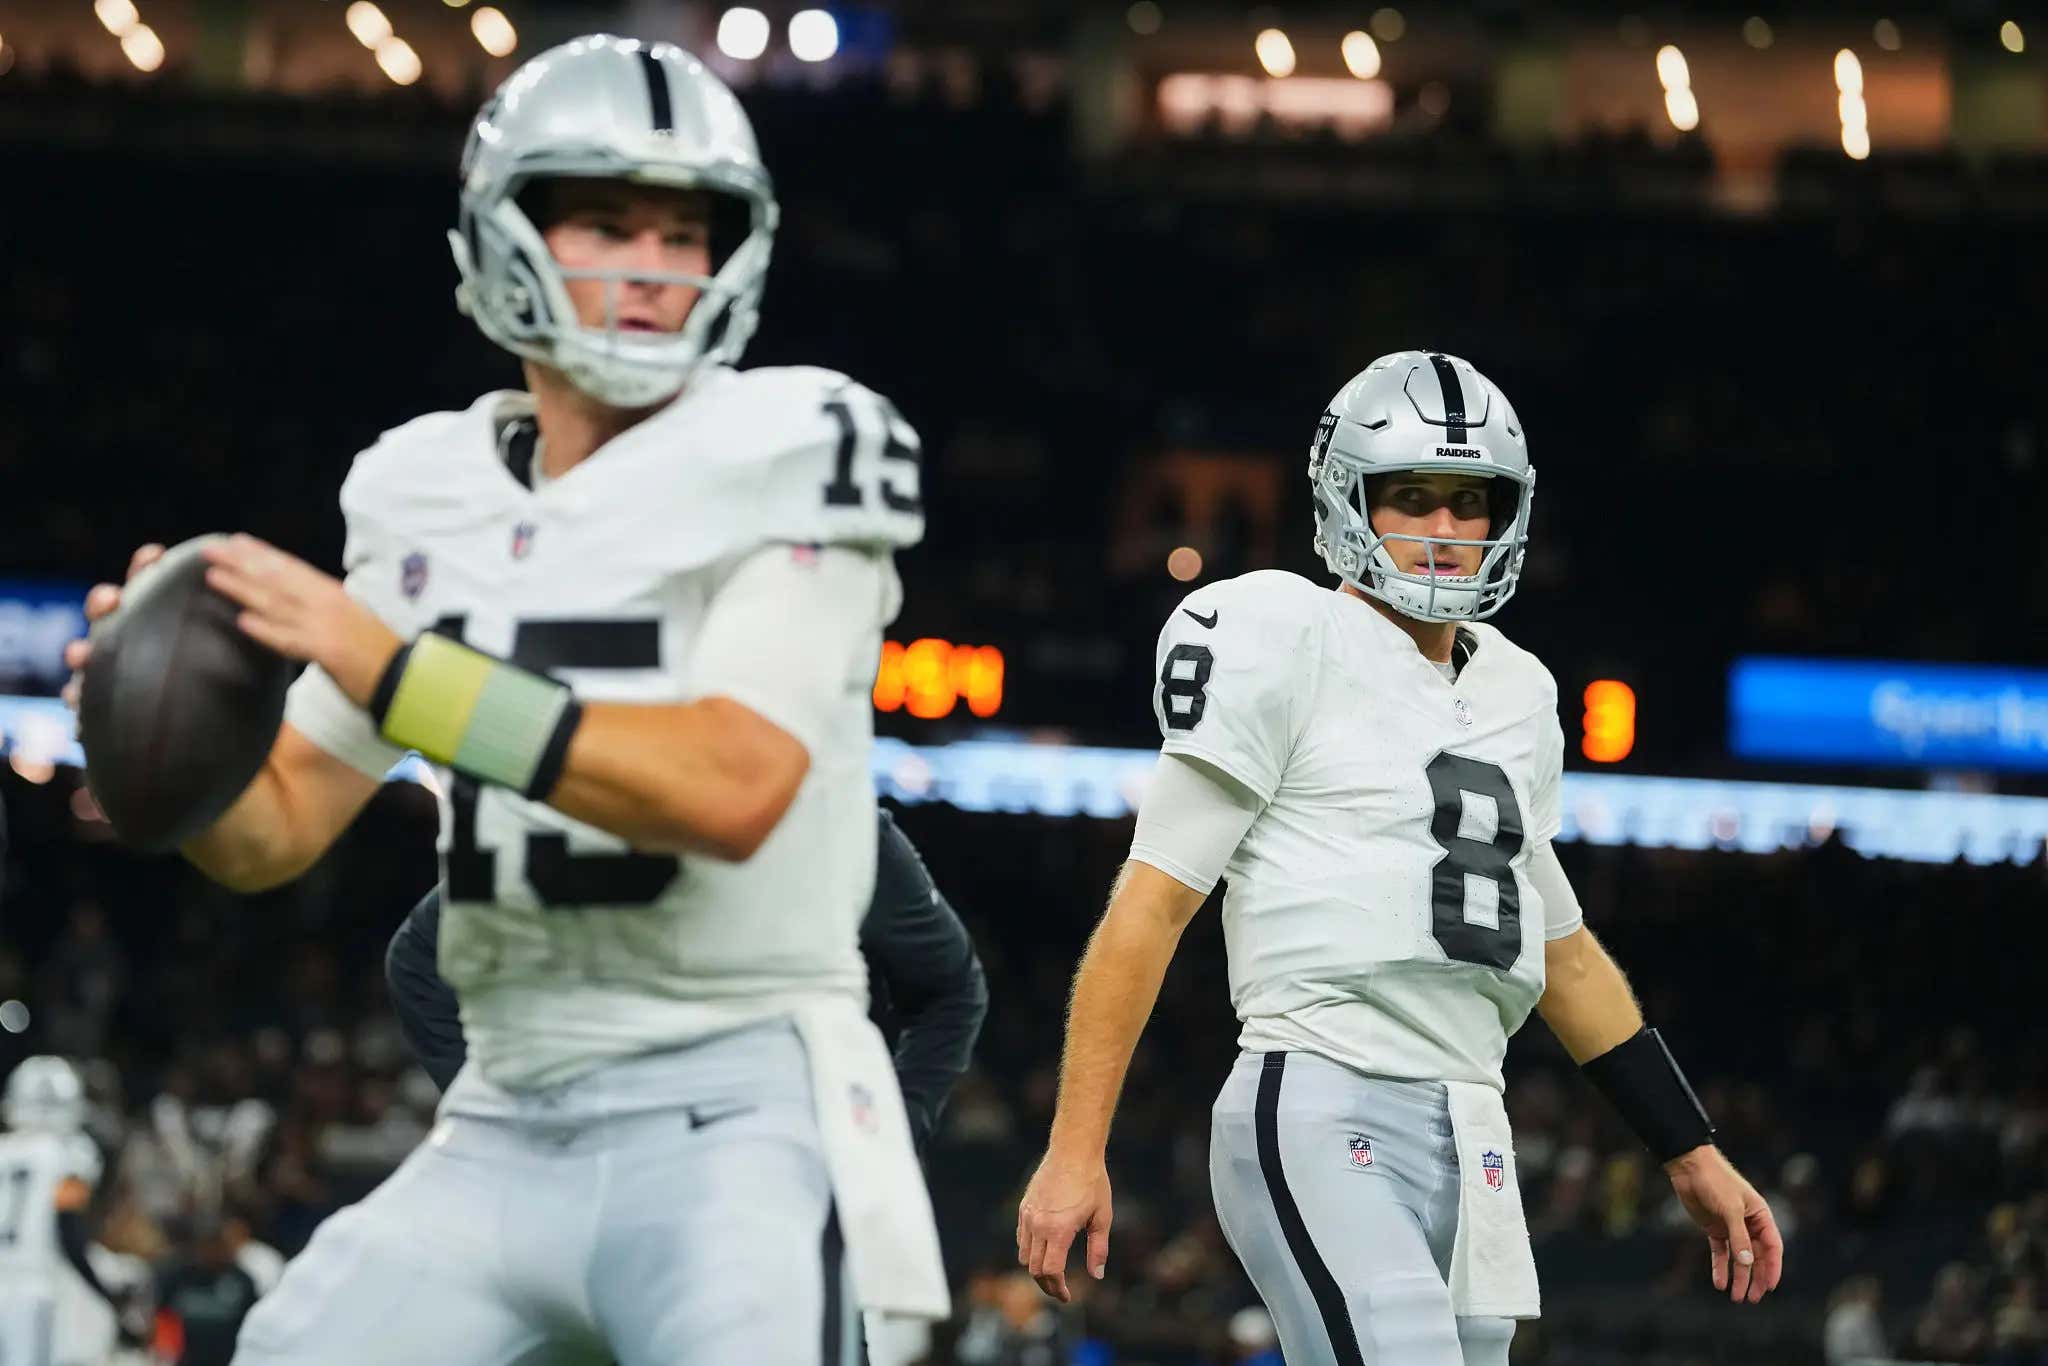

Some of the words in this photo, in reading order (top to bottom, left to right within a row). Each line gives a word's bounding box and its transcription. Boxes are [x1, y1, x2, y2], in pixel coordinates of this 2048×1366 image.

[822, 401, 921, 512] 15
[1436, 447, 1481, 459] RAIDERS
[1161, 644, 1215, 731] 8
[1425, 750, 1525, 972] 8
[1353, 1150, 1371, 1163] NFL
[1485, 1169, 1502, 1188] NFL
